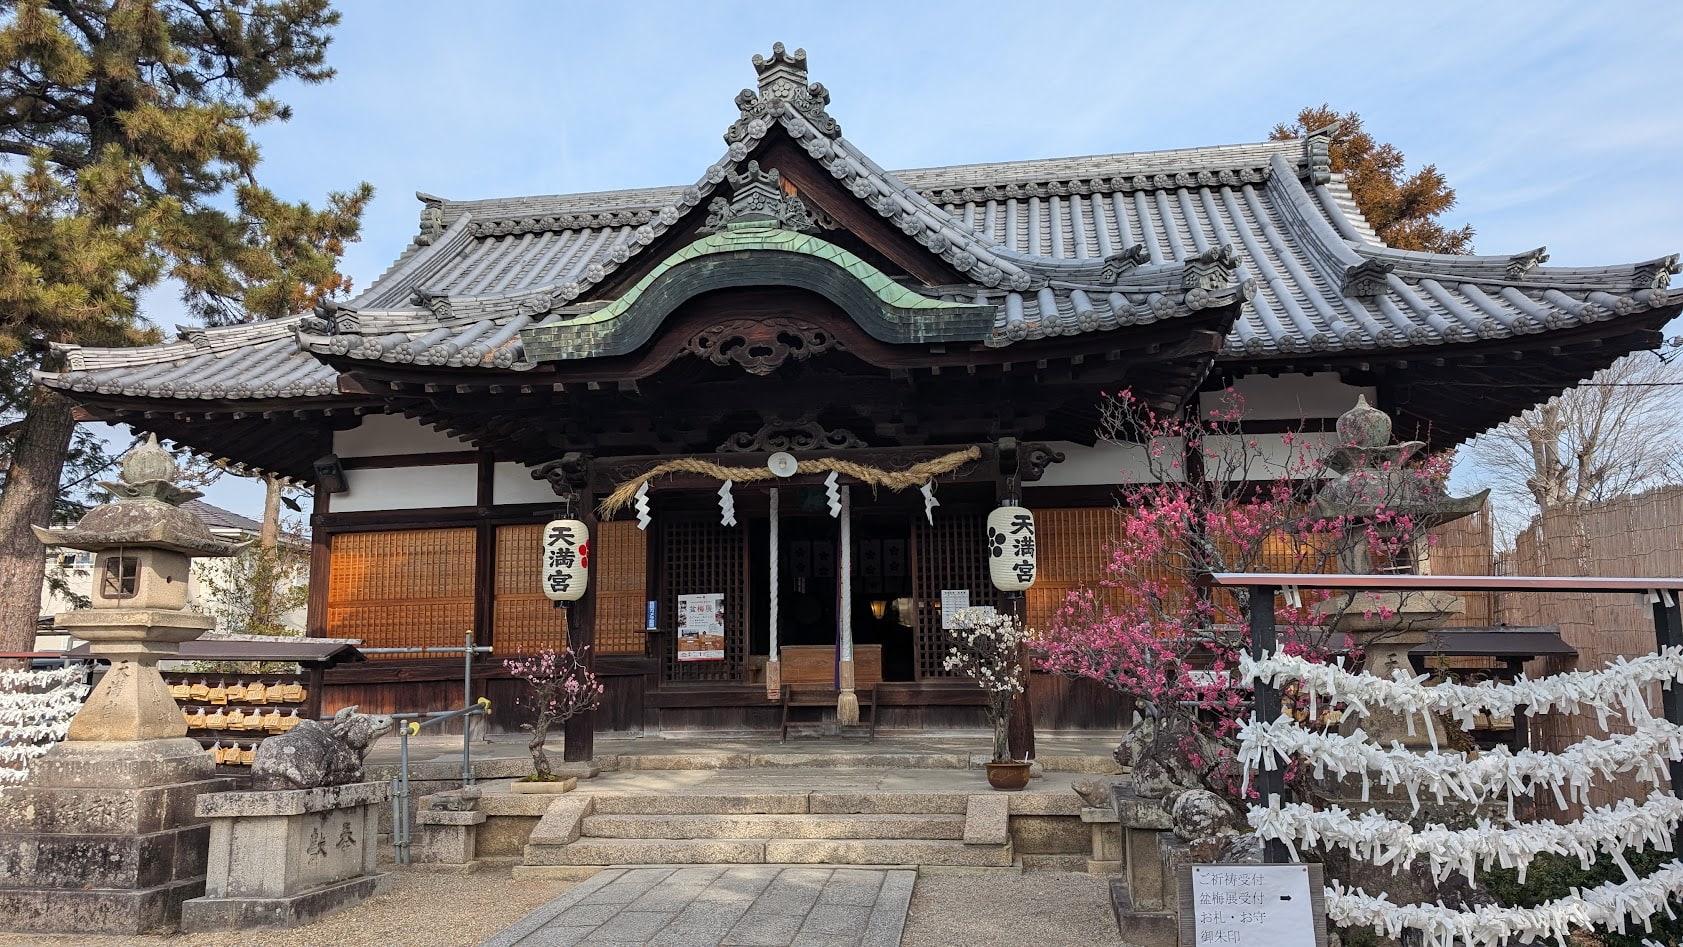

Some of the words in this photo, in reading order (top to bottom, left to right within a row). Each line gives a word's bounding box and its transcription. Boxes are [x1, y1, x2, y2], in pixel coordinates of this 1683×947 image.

[1009, 514, 1035, 583] 天満宮
[547, 526, 576, 593] 天満宮
[1199, 872, 1265, 887] ご祈祷受付
[1199, 891, 1265, 906] 盆梅展受付
[1200, 910, 1267, 925] お札・お守
[1200, 929, 1241, 945] 御朱印
